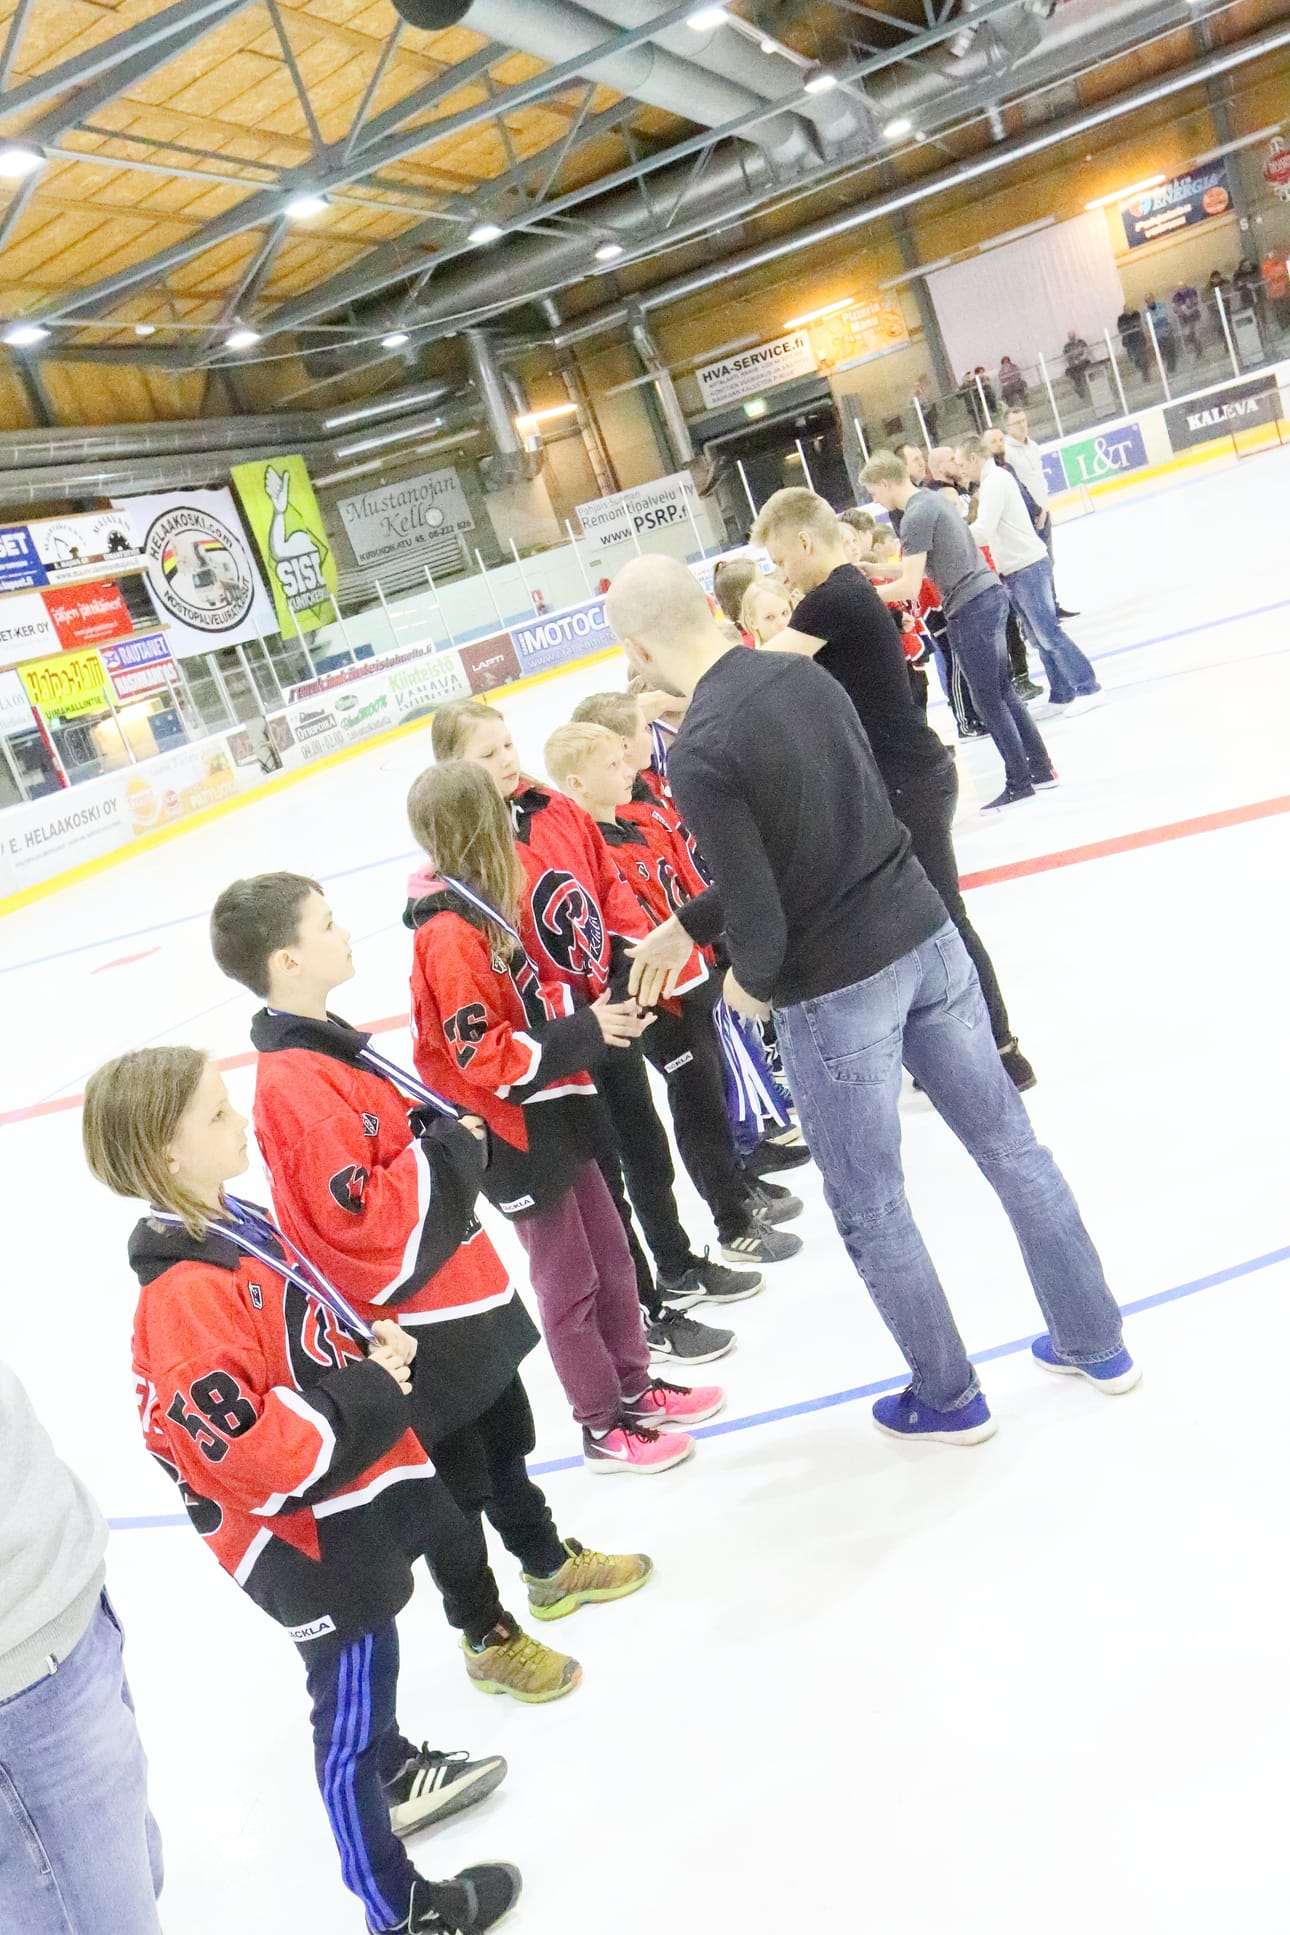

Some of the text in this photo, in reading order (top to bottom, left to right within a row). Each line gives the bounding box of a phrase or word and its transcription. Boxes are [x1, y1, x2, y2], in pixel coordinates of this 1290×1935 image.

[702, 337, 804, 383] HVA-SERVICE.fi
[1186, 399, 1259, 431] KALEVA
[150, 513, 233, 560] HELAAKOSKI.com
[0, 624, 34, 643] ET-KER
[24, 805, 101, 848] HELAAKOSKI
[103, 797, 117, 815] OY
[166, 1369, 258, 1463] 58
